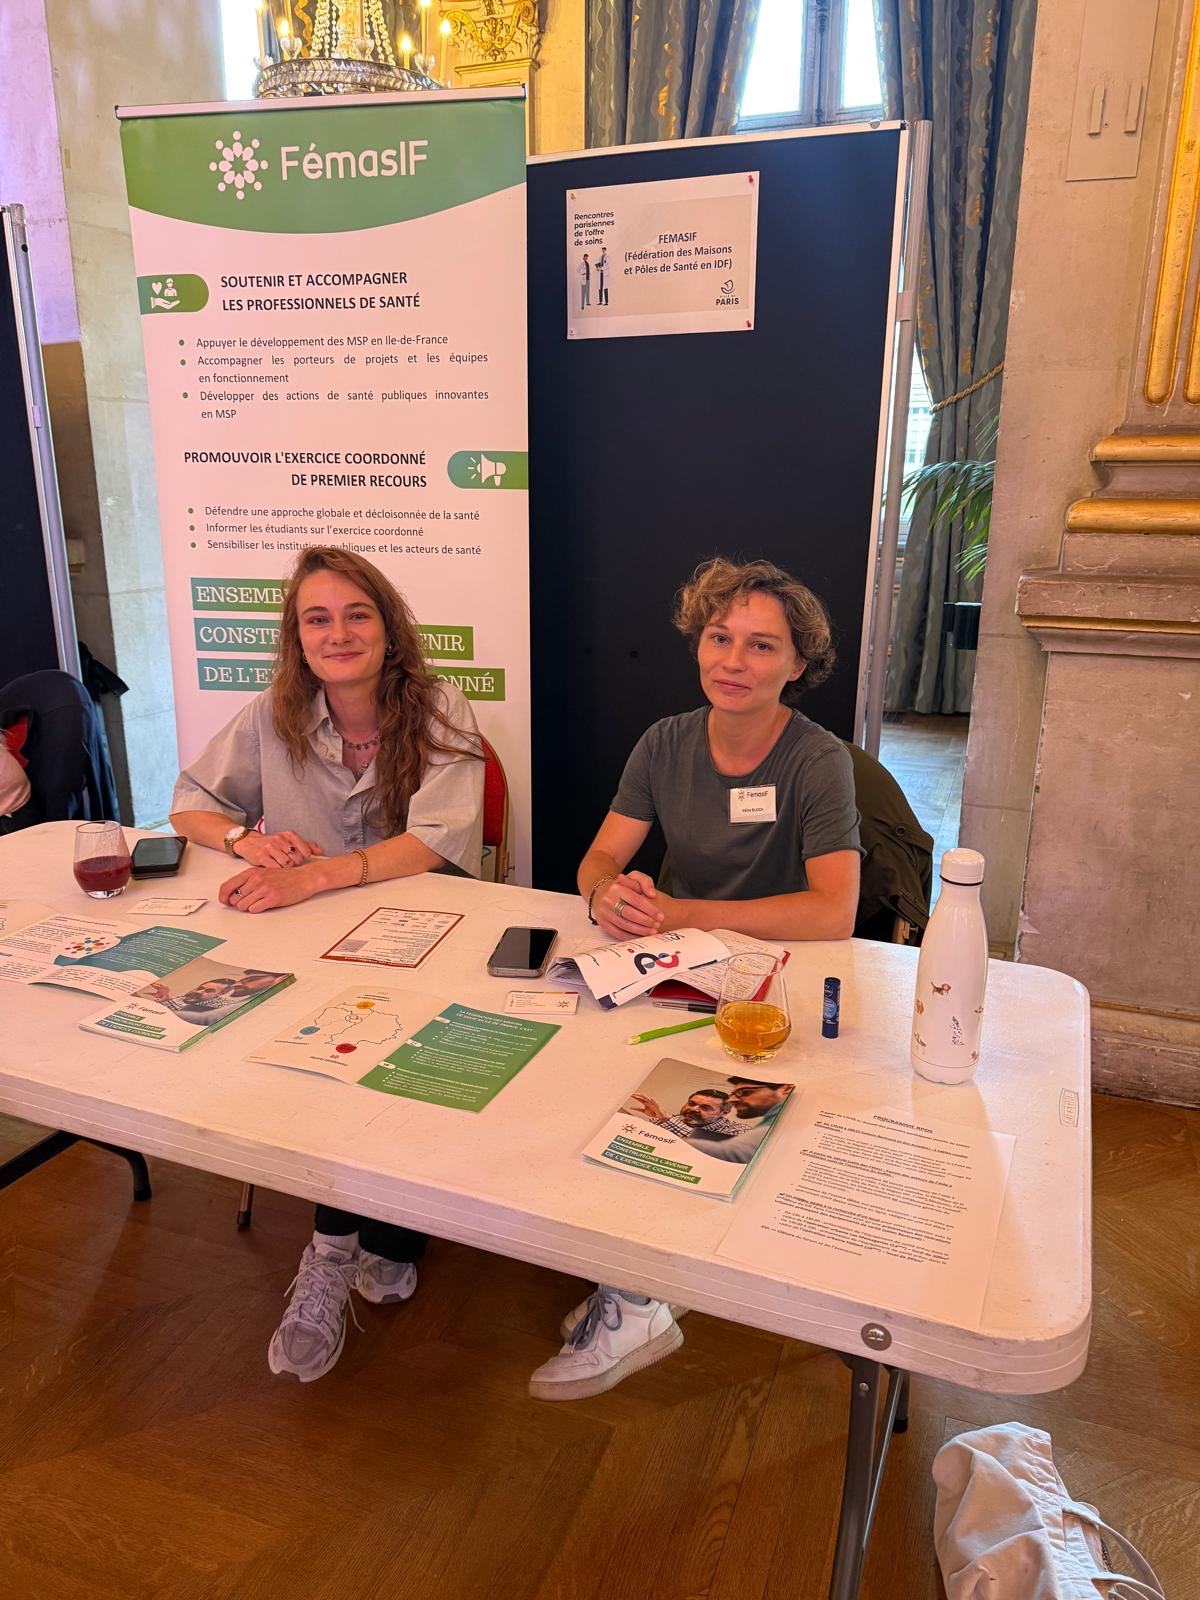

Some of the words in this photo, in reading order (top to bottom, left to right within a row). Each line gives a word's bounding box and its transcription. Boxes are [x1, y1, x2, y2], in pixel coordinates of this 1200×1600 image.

[280, 139, 429, 181] FémasIF
[574, 211, 614, 220] Rencontres
[574, 220, 614, 230] parisiennes
[658, 232, 697, 244] FEMASIF
[624, 250, 675, 262] (Fédération
[677, 248, 692, 258] des
[694, 245, 732, 255] Maisons
[624, 266, 632, 275] et
[635, 264, 658, 274] Pôles
[660, 263, 671, 272] de
[673, 261, 698, 271] Santé
[700, 261, 712, 270] en
[714, 259, 732, 269] IDF)
[220, 276, 285, 288] SOUTENIR
[288, 274, 302, 286] ET
[306, 272, 408, 286] ACCOMPAGNER
[222, 299, 243, 311] LES
[246, 297, 356, 311] PROFESSIONNELS
[360, 297, 375, 309] DE
[379, 293, 421, 308] SANTÉ
[196, 337, 236, 350] Appuyer
[239, 337, 248, 347] le
[250, 336, 324, 349] développement
[327, 336, 344, 347] des
[346, 335, 368, 346] MSP
[371, 338, 383, 346] en
[385, 334, 448, 346] Ile-de-France
[197, 355, 262, 368] Accompagner
[272, 355, 285, 366] les
[293, 355, 334, 368] porteurs
[344, 354, 356, 365] de
[365, 354, 398, 366] projets
[407, 354, 417, 364] et
[427, 353, 440, 364] les
[449, 353, 488, 365] équipes
[199, 375, 210, 383] en
[212, 372, 289, 384] fonctionnement
[200, 390, 255, 403] Développer
[262, 390, 279, 401] des
[286, 390, 320, 401] actions
[328, 390, 340, 400] de
[347, 390, 374, 401] santé
[381, 389, 427, 402] publiques
[435, 389, 489, 400] innovantes
[201, 410, 213, 419] en
[216, 409, 237, 420] MSP
[184, 452, 272, 464] PROMOUVOIR
[275, 452, 341, 465] L'EXERCICE
[344, 450, 426, 465] COORDONNÉ
[291, 474, 307, 486] DE
[310, 474, 366, 487] PREMIER
[369, 475, 427, 488] RECOURS
[205, 506, 248, 516] Défendre
[271, 508, 314, 519] approche
[316, 508, 351, 520] globale
[353, 509, 362, 518] et
[365, 509, 427, 520] décloisonnée
[429, 510, 440, 520] de
[442, 511, 451, 520] la
[453, 511, 480, 520] santé
[206, 524, 246, 533] Informer
[249, 524, 263, 532] les
[265, 524, 307, 534] étudiants
[326, 524, 371, 535] l'exercice
[374, 526, 424, 536] coordonné
[207, 540, 260, 550] Sensibiliser
[262, 541, 274, 550] les
[378, 544, 388, 553] et
[390, 544, 403, 553] les
[406, 545, 439, 554] acteurs
[441, 545, 453, 555] de
[454, 546, 482, 555] santé
[195, 586, 289, 604] ENSEMB
[204, 666, 233, 683] DE
